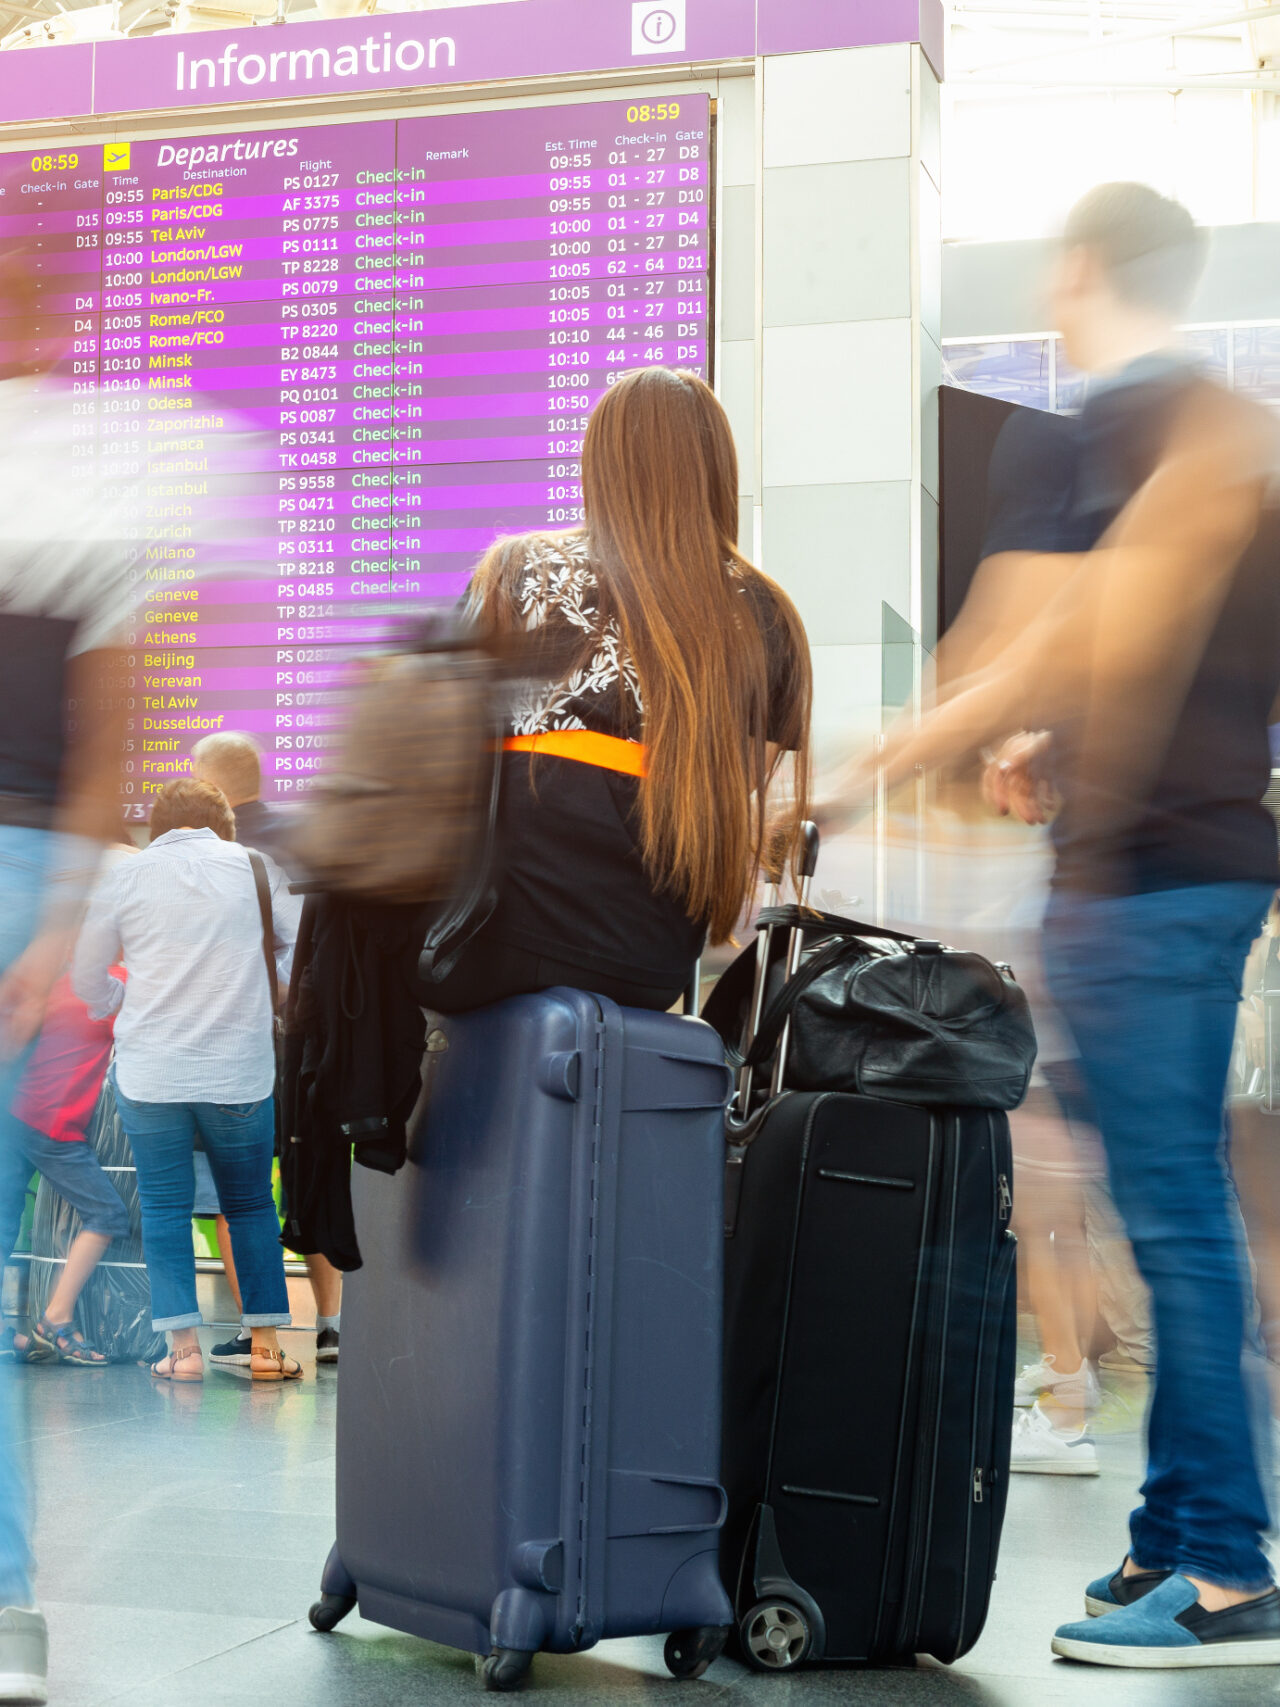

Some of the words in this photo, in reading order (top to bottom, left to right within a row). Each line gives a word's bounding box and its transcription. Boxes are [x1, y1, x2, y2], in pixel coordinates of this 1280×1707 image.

[174, 32, 458, 91] Information
[626, 103, 680, 123] 08:59
[614, 131, 668, 146] Check-in
[675, 128, 704, 142] Gate
[545, 141, 566, 152] Est.
[570, 138, 598, 150] Time
[679, 145, 699, 160] D8
[157, 137, 299, 170] Departures
[425, 147, 470, 161] Remark
[549, 153, 592, 170] 09:55
[31, 154, 79, 172] 08:59
[299, 159, 332, 173] Flight
[112, 174, 139, 187] Time
[183, 165, 247, 181] Destination
[355, 166, 426, 185] Check-in
[679, 167, 700, 182] D8
[21, 180, 67, 195] Check-in
[74, 178, 100, 190] Gate
[283, 176, 301, 191] PS
[303, 173, 340, 189] 0127
[549, 175, 592, 192] 09:55
[105, 189, 144, 205] 09:55
[152, 182, 224, 201] Paris/CDG
[355, 187, 426, 206] Check-in
[678, 188, 704, 204] D10
[281, 197, 302, 212] AF
[303, 194, 340, 210] 3375
[549, 196, 591, 213] 09:55
[105, 209, 144, 225] 09:55
[151, 203, 223, 222] Paris/CDG
[355, 209, 425, 227] Check-in
[678, 211, 699, 226] D4
[282, 218, 300, 233] PS
[302, 215, 339, 231] 0775
[549, 218, 591, 235] 10:00
[105, 230, 144, 246] 09:55
[150, 227, 174, 243] Tel
[174, 225, 206, 241] Aviv
[354, 230, 425, 249] Check-in
[678, 233, 699, 248] D4
[150, 243, 244, 264] London/LGW
[282, 239, 300, 254] PS
[302, 237, 339, 253] 0111
[549, 240, 591, 257] 10:00
[105, 251, 144, 267] 10:00
[281, 260, 301, 275] TP
[303, 258, 339, 274] 8228
[677, 255, 703, 270] D21
[150, 264, 243, 285] London/LGW
[549, 262, 591, 278] 10:05
[104, 272, 143, 287] 10:00
[281, 281, 300, 296] PS
[301, 279, 339, 295] 0079
[104, 292, 143, 308] 10:05
[150, 288, 215, 305] Ivano-Fr.
[149, 309, 225, 327] Rome/FCO
[281, 304, 299, 319] PS
[301, 302, 338, 317] 0305
[104, 315, 142, 330] 10:05
[149, 330, 225, 349] Rome/FCO
[279, 325, 300, 340] TP
[301, 323, 338, 339] 8220
[103, 335, 142, 351] 10:05
[148, 352, 193, 369] Minsk
[280, 346, 299, 361] B2
[302, 344, 339, 360] 0844
[103, 356, 142, 372] 10:10
[148, 373, 193, 390] Minsk
[280, 367, 299, 383] EY
[300, 365, 337, 381] 8473
[278, 454, 297, 467] TK
[301, 451, 337, 466] 0458
[278, 477, 296, 490] PS
[299, 475, 335, 489] 9558
[144, 632, 197, 645] Athens
[144, 653, 195, 669] Beijing
[143, 675, 202, 689] Yerevan
[143, 697, 164, 710] Tel
[168, 695, 198, 709] Aviv
[143, 715, 224, 731] Dusseldorf
[143, 738, 180, 752] Izmir
